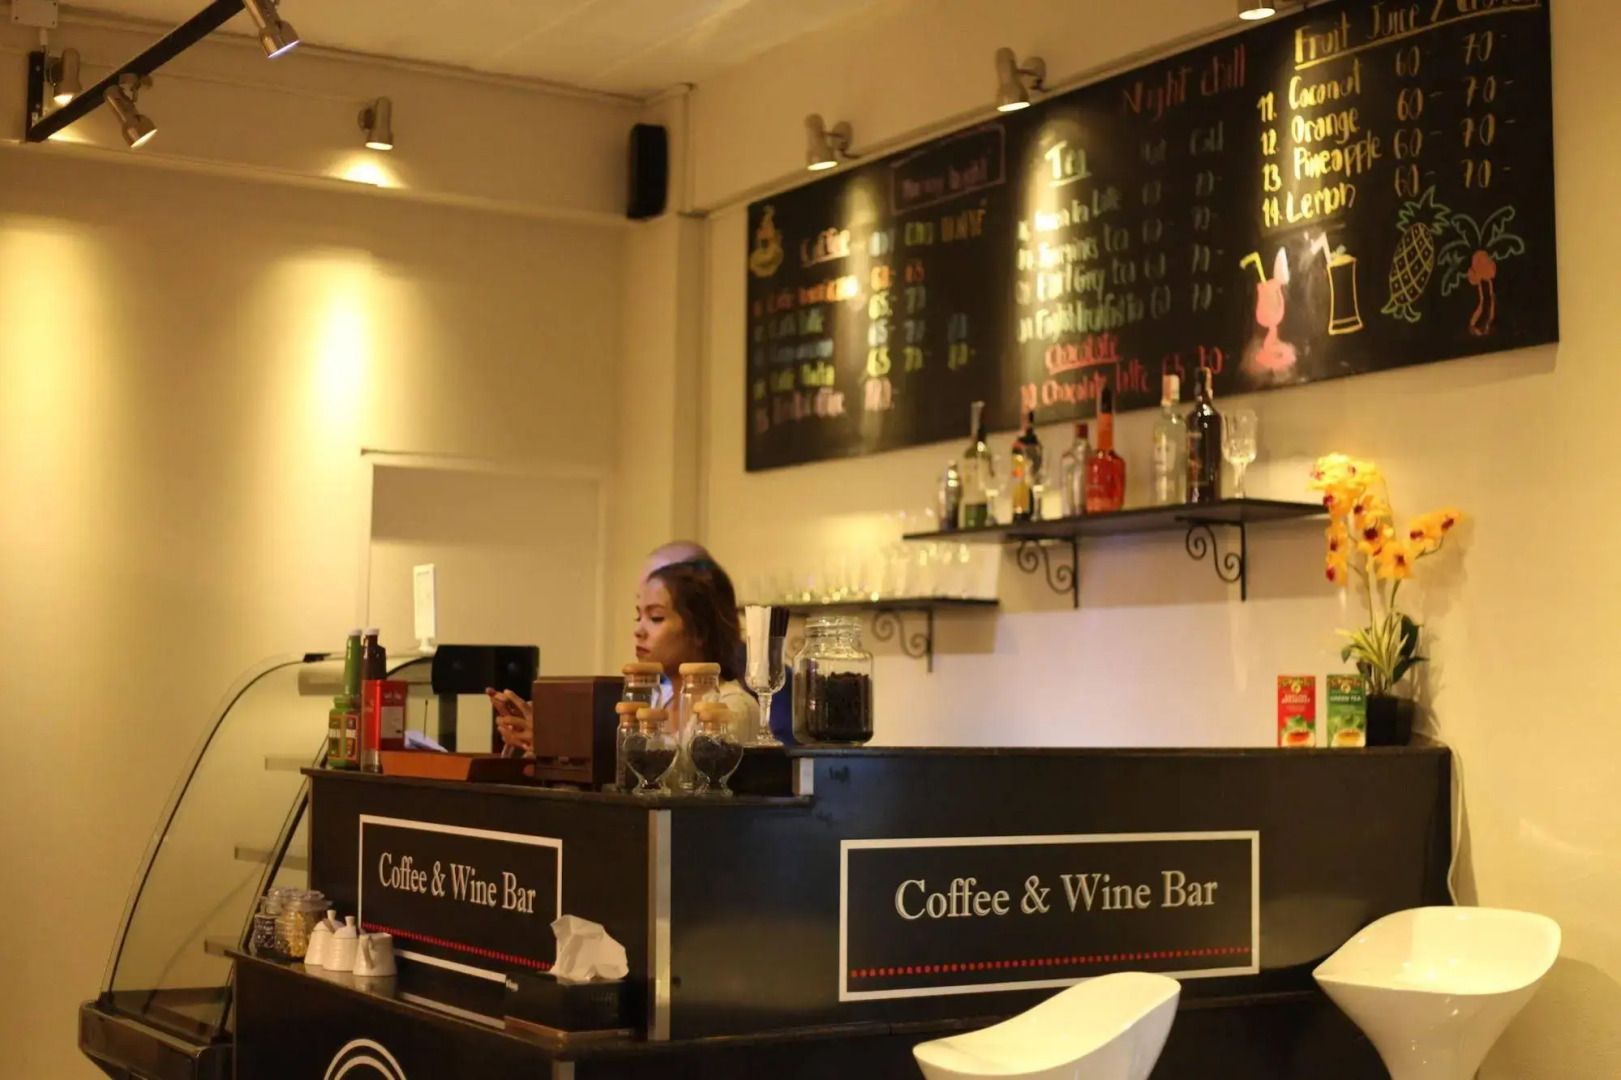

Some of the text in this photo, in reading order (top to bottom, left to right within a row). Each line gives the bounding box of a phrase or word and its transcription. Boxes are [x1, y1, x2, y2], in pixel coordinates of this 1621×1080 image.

[1295, 11, 1351, 63] Fruit
[1289, 58, 1362, 110] Coconut
[1291, 107, 1360, 144] Orange
[1293, 129, 1382, 181] Pineapple
[1286, 182, 1357, 223] Lemon
[379, 852, 536, 914] Coffee & Wine Bar
[895, 870, 1218, 920] Coffee & Wine Bar
